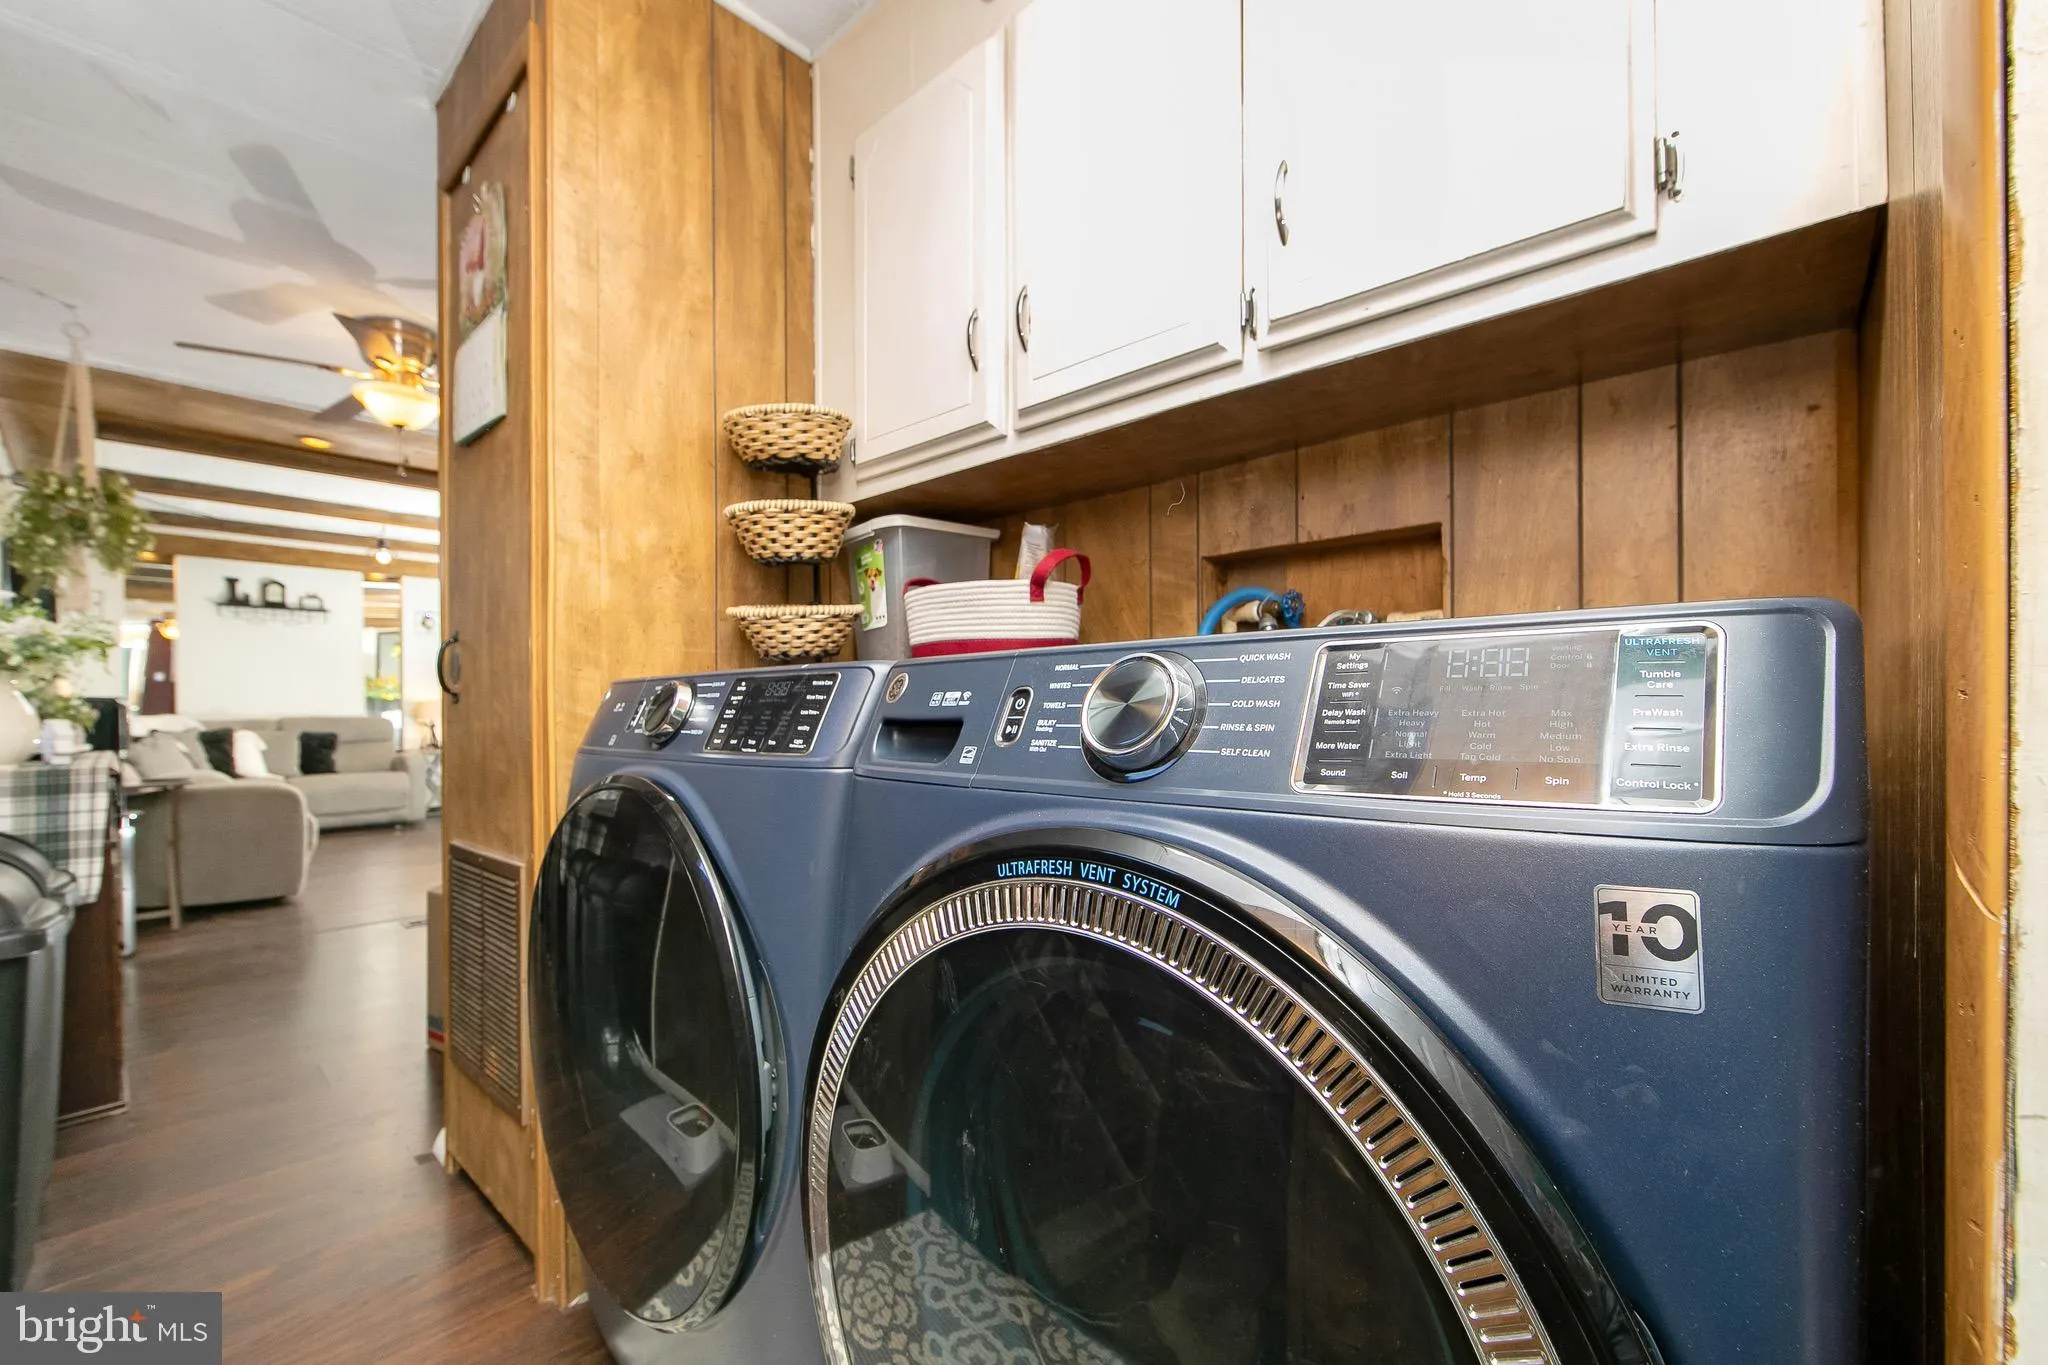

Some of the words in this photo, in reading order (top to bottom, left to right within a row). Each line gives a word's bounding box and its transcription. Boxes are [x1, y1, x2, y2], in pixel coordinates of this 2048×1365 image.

[1625, 637, 1700, 646] ULTRAFRESH
[1646, 648, 1678, 656] VENT
[1240, 654, 1265, 663] QUICK
[1266, 652, 1291, 660] WASH
[1349, 653, 1361, 661] My
[1055, 664, 1080, 672] NORMAL
[1336, 662, 1369, 670] Settings
[1640, 670, 1681, 678] Tumble
[1241, 676, 1286, 684] DELICATES
[1348, 681, 1370, 689] Saver
[1646, 680, 1674, 689] Care
[1232, 700, 1254, 708] COLD
[1256, 700, 1280, 708] WASH
[1322, 709, 1344, 717] Delay
[1412, 710, 1439, 718] Heavy
[1632, 708, 1684, 717] PreWash
[1254, 724, 1275, 732] SPIN
[1474, 720, 1491, 728] Hot
[1550, 720, 1574, 729] High
[1540, 732, 1582, 740] Medium
[1337, 742, 1360, 750] Water
[1470, 742, 1492, 750] Cold
[1550, 744, 1570, 752] Low
[1624, 742, 1653, 751] Extra
[1657, 744, 1690, 753] Rinse
[1220, 748, 1241, 756] SELF
[1242, 748, 1271, 757] CLEAN
[1410, 751, 1432, 760] Light
[1461, 753, 1477, 761] Tap
[1478, 753, 1501, 761] Cold
[1539, 755, 1553, 763] No
[1556, 756, 1581, 764] Spin
[1320, 769, 1346, 777] Sound
[1391, 771, 1408, 779] Soil
[1460, 773, 1487, 783] Temp
[1545, 776, 1570, 786] Spin
[1616, 778, 1660, 789] Control
[1663, 780, 1692, 790] Lock
[997, 860, 1073, 878] ULTRAFRESH
[1080, 862, 1116, 884] VENT
[1122, 873, 1181, 909] SYSTEM
[1598, 900, 1698, 962] 10
[1612, 924, 1657, 935] YEAR
[1622, 973, 1678, 986] LIMITED
[1610, 984, 1690, 1000] WARRANTY
